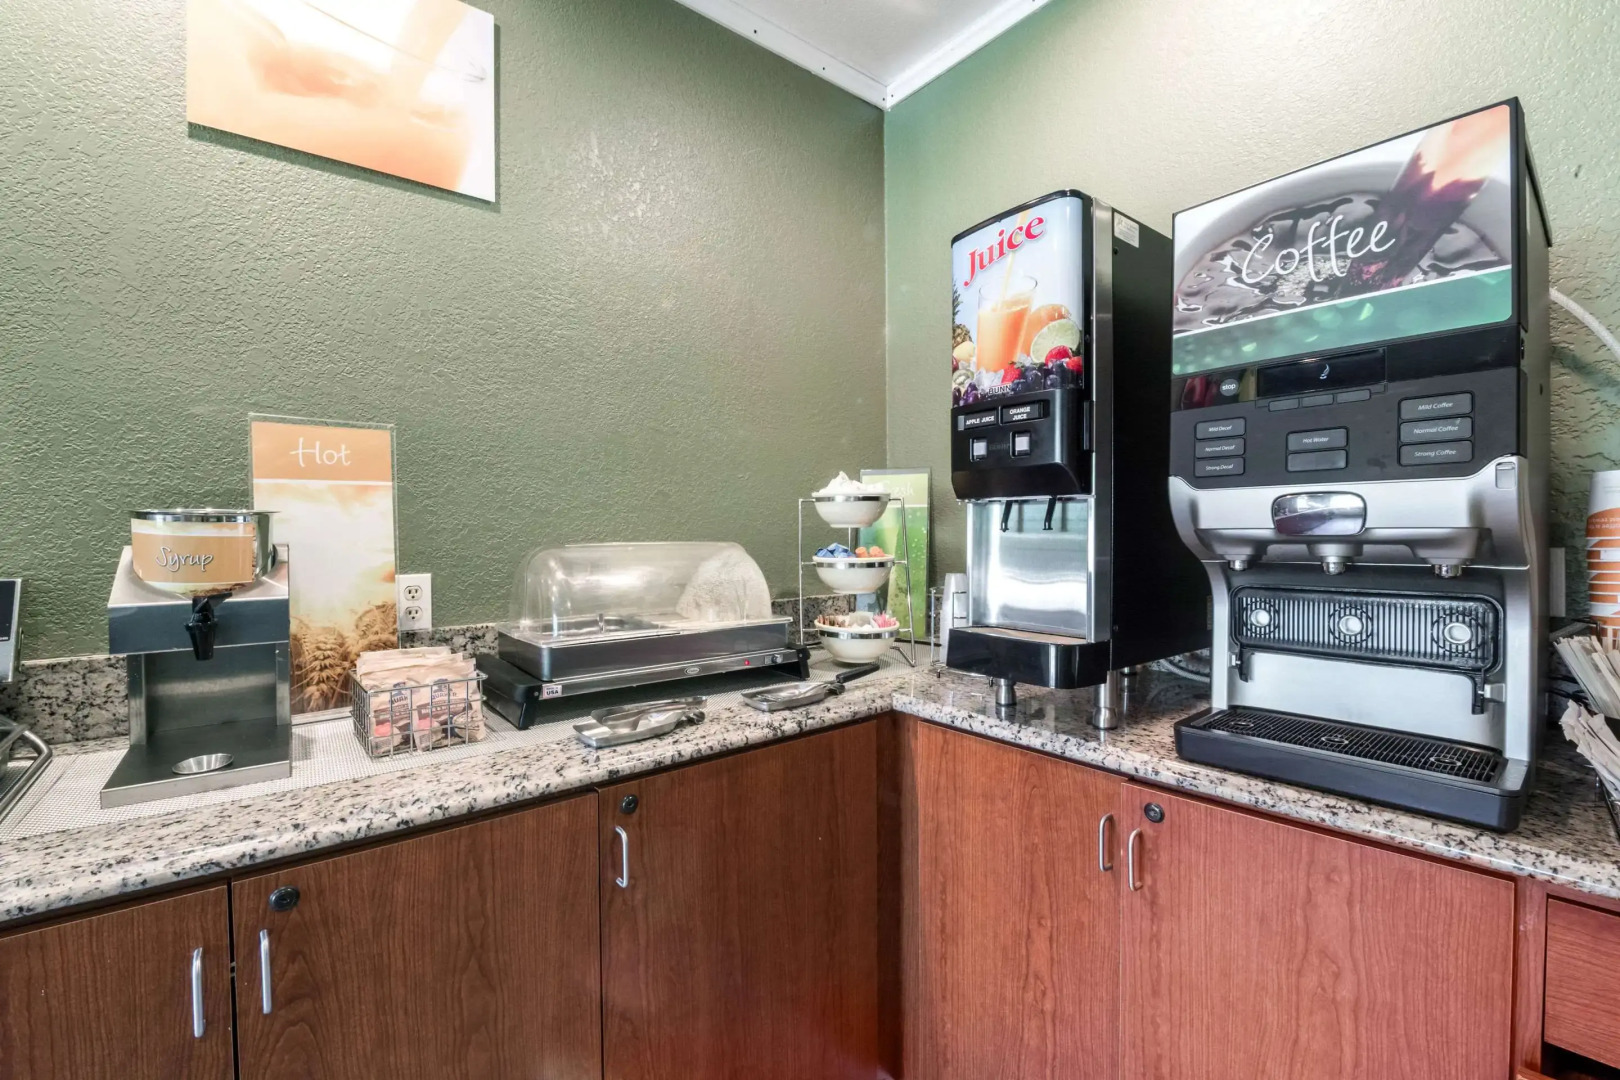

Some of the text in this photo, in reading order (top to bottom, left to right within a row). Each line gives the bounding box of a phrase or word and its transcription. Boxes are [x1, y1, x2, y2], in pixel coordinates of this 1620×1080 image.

[963, 215, 1046, 287] Juice
[1241, 214, 1396, 283] Coffee
[988, 384, 1011, 395] BUNN
[1221, 383, 1236, 391] stop
[1009, 406, 1031, 414] ORANGE
[289, 437, 351, 468] Hot
[155, 545, 214, 573] Syrup
